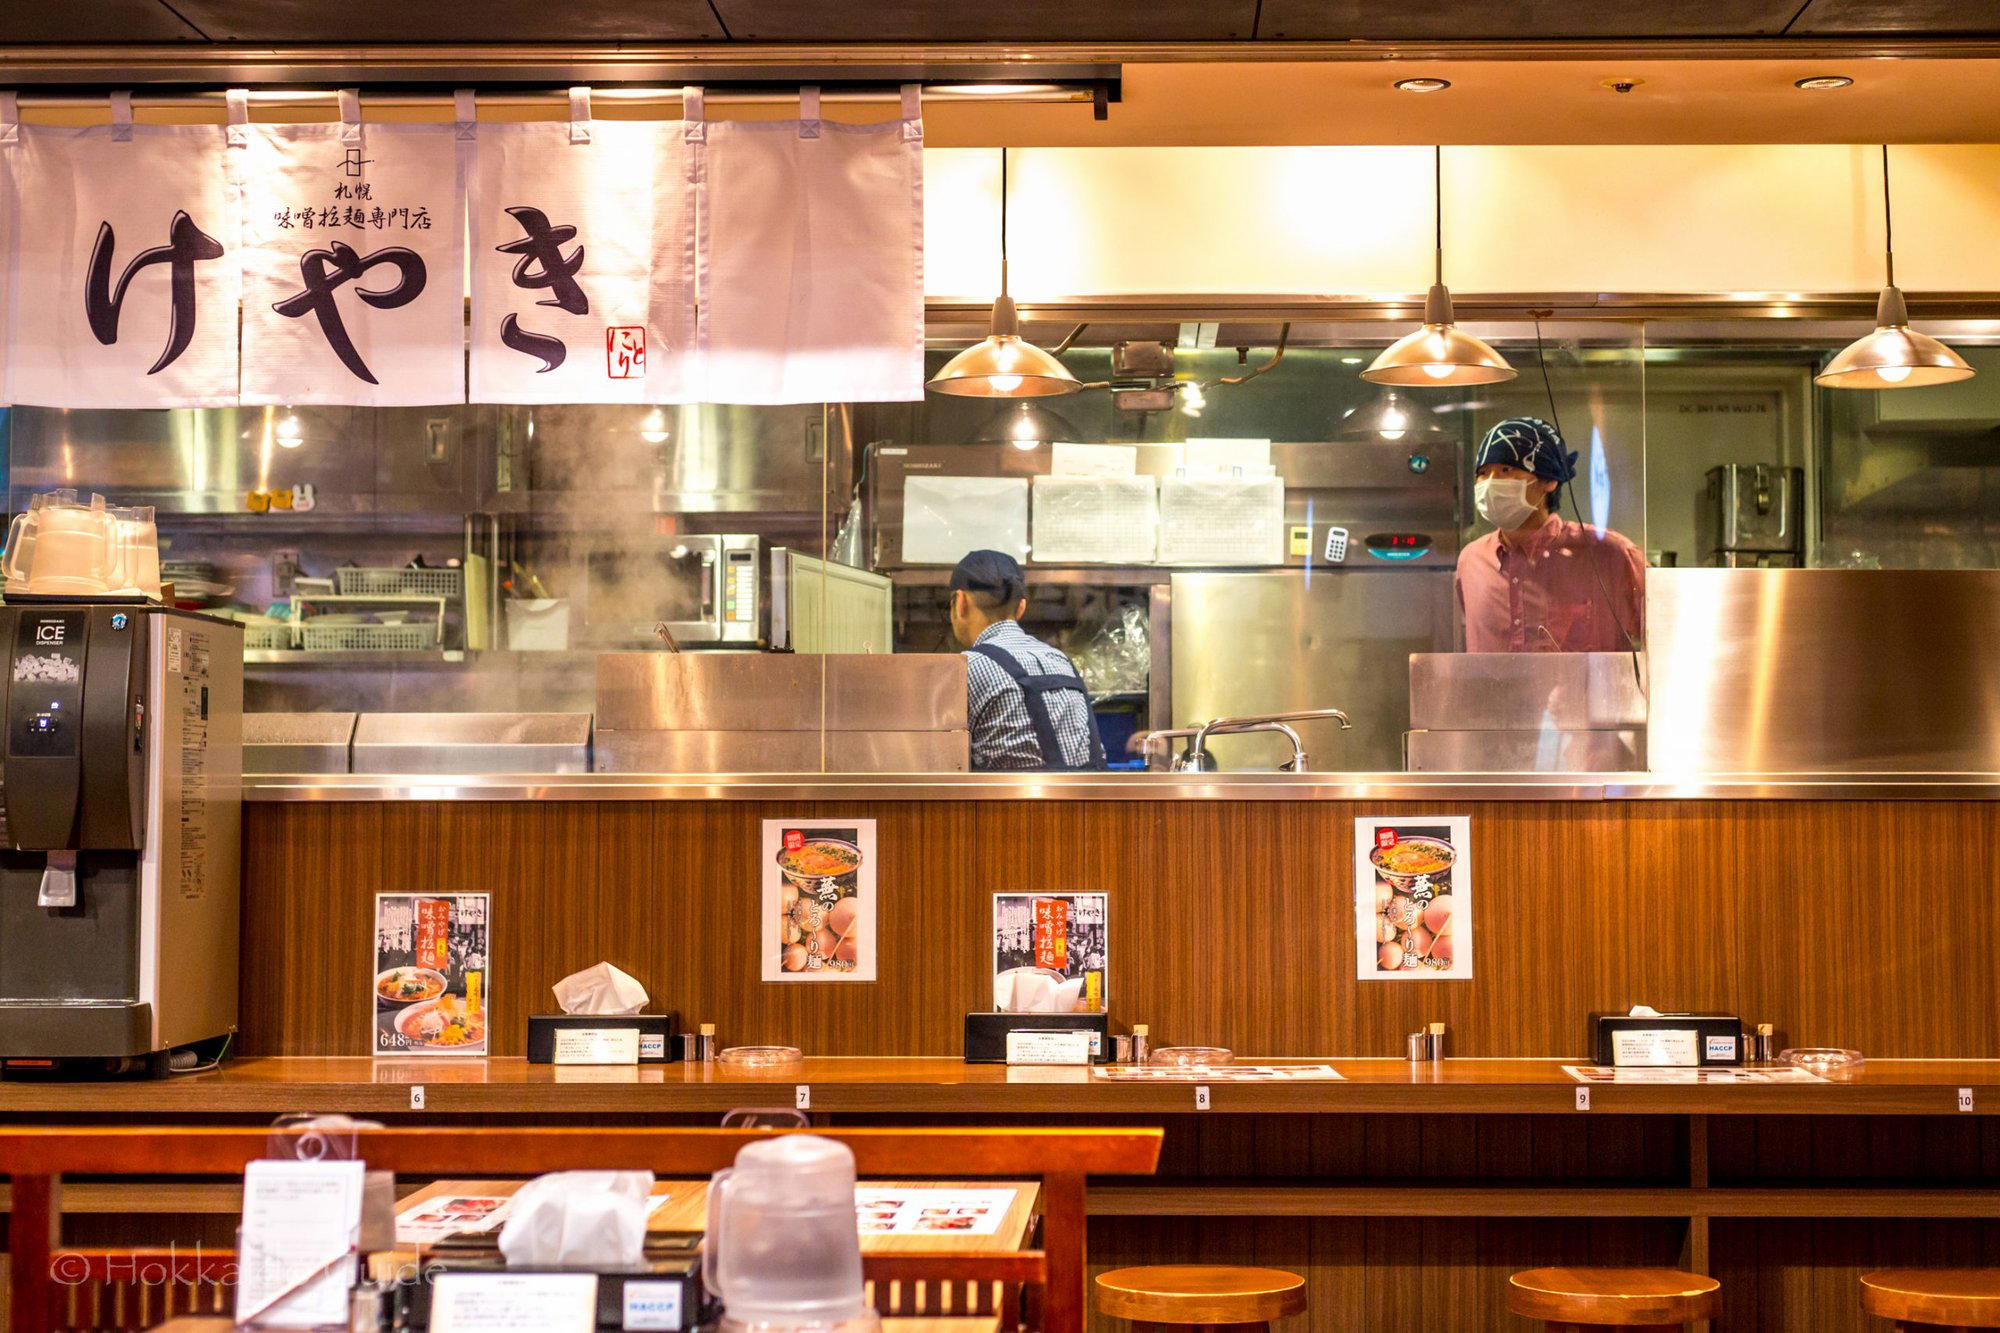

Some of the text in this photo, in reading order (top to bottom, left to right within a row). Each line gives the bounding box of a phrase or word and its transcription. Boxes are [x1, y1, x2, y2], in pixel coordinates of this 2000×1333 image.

[335, 182, 373, 201] 札幌
[85, 206, 589, 385] けやき
[36, 626, 65, 640] ICE
[414, 1093, 421, 1103] 6
[800, 1092, 806, 1102] 7
[1199, 1093, 1206, 1103] 8
[1580, 1094, 1586, 1104] 9
[1960, 1096, 1971, 1106] 10
